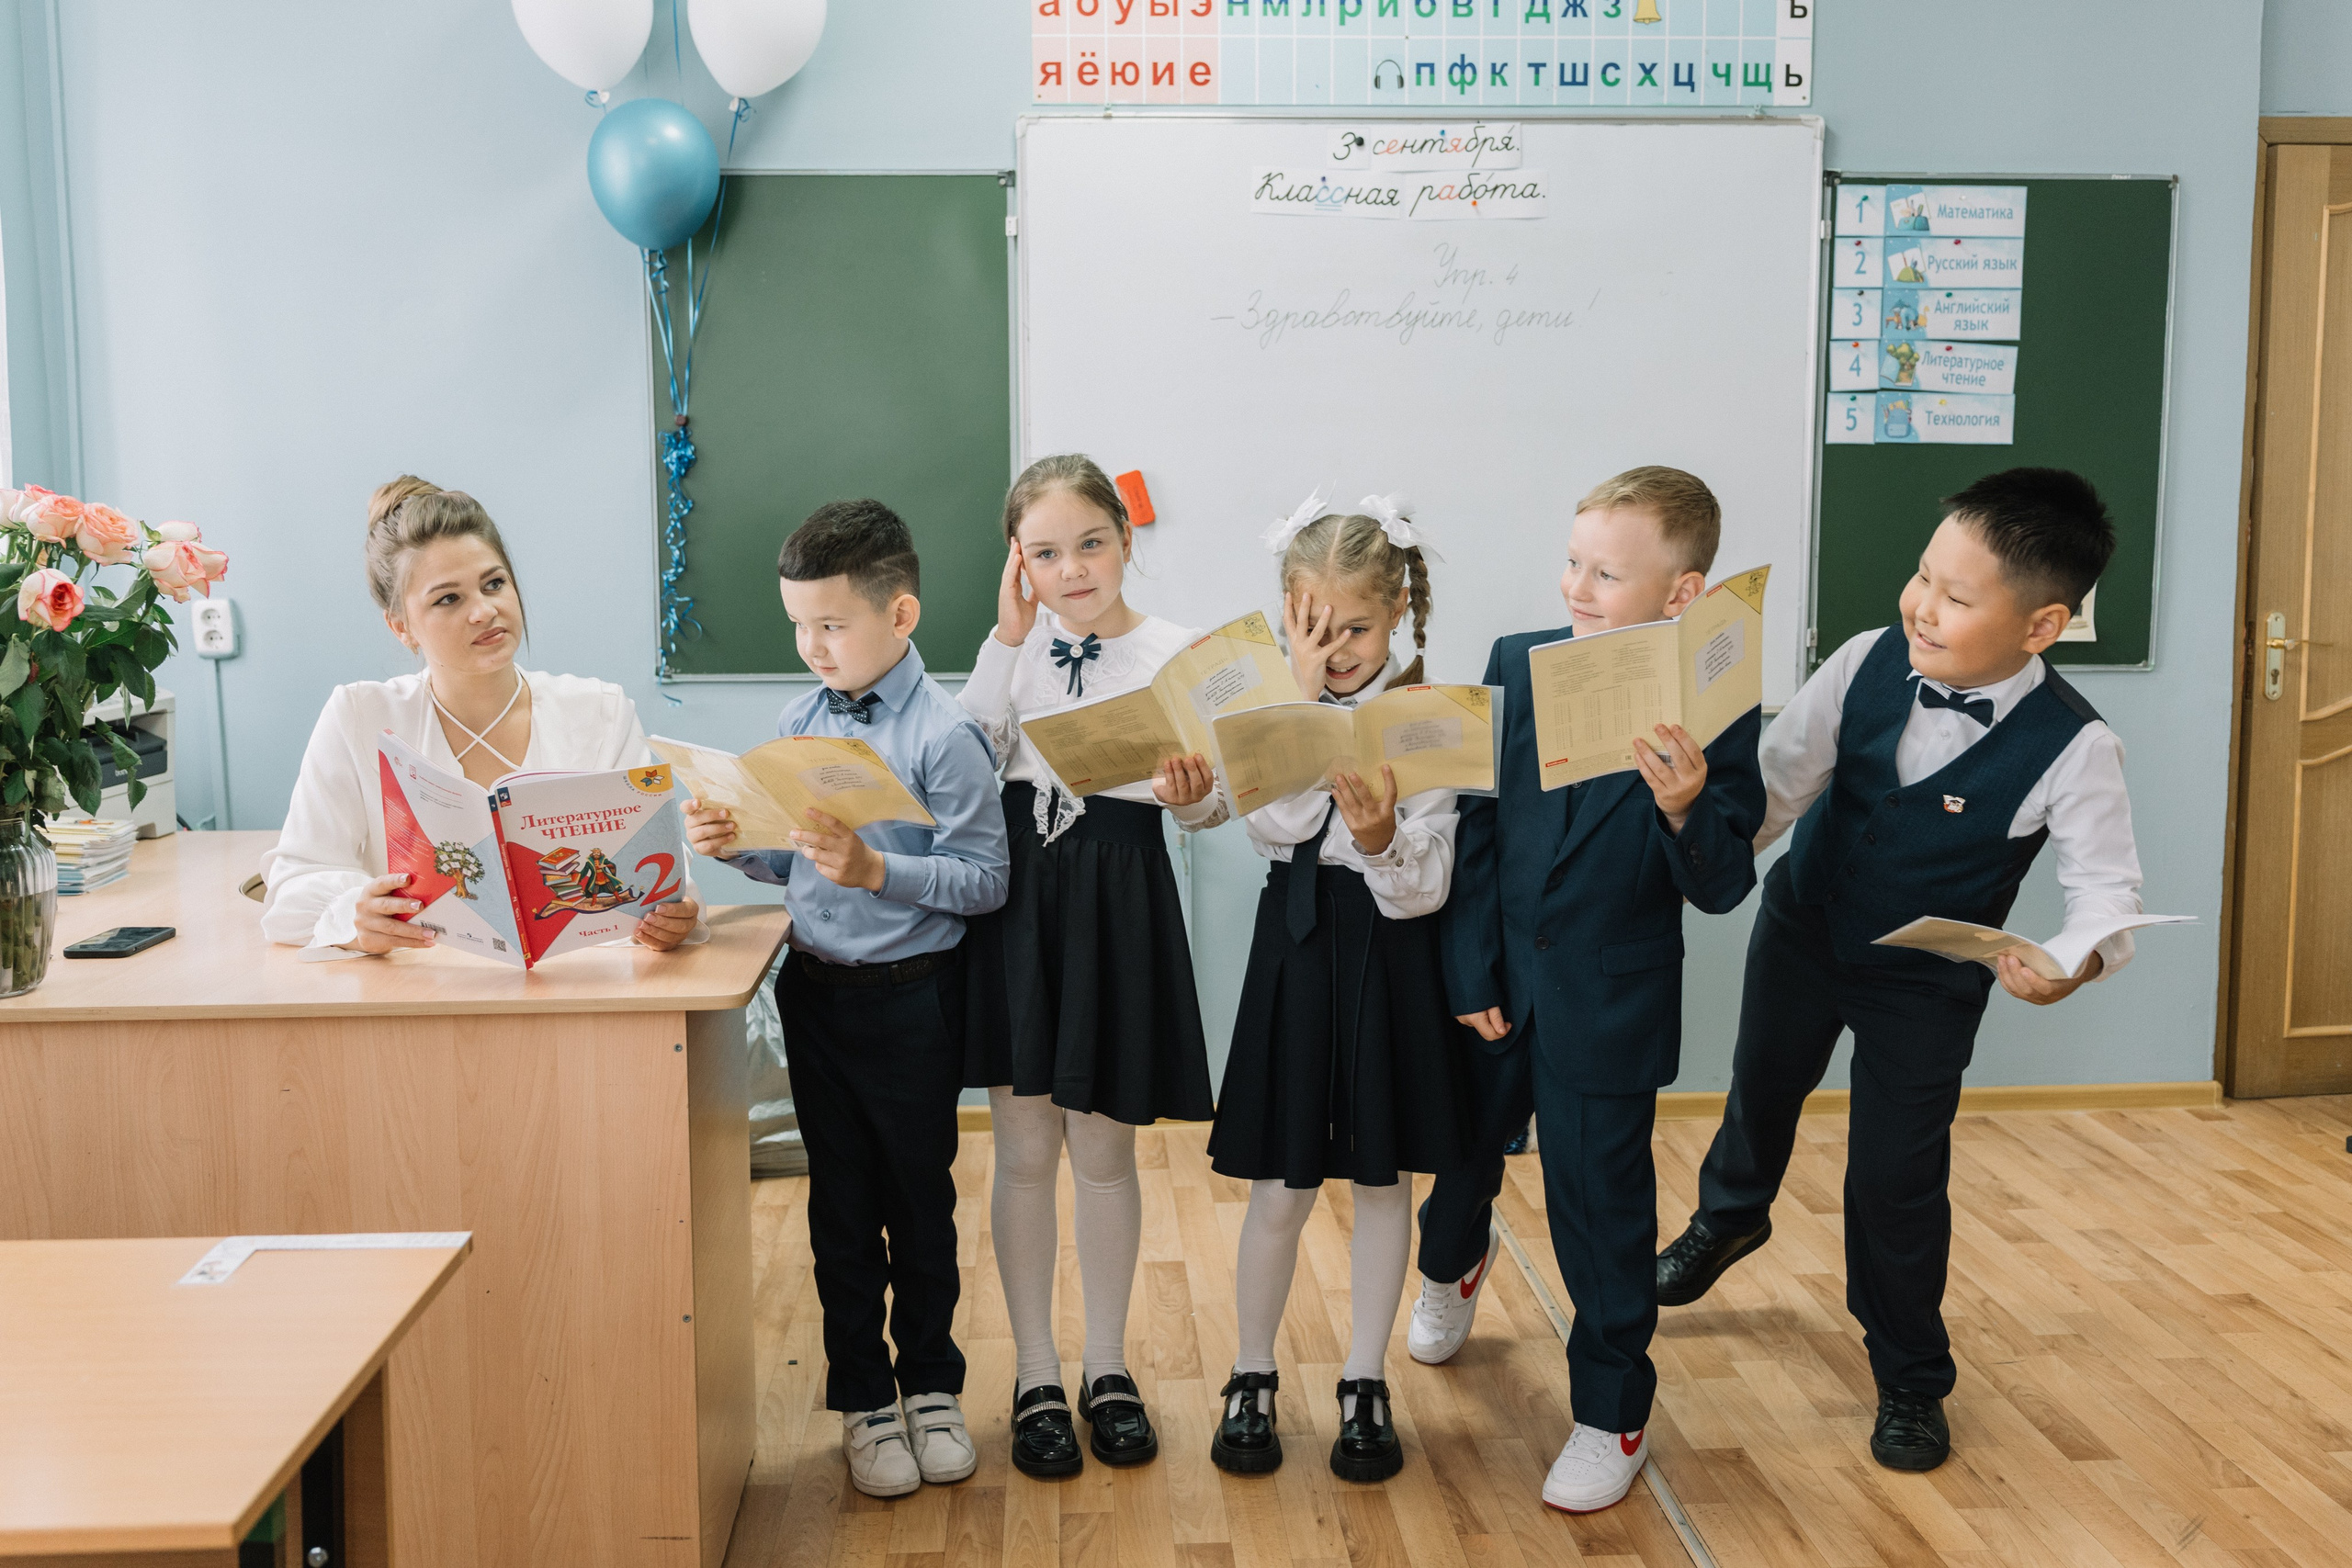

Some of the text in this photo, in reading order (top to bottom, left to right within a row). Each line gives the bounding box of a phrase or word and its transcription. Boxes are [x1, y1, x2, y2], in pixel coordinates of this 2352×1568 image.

[1039, 51, 1804, 96] я ё ю и е п ф к т ш с х ц ч щ ь
[1254, 172, 1400, 206] Классная
[1937, 204, 2014, 220] Математика
[1854, 251, 2018, 275] 2 Русский язык
[1852, 298, 2009, 326] 3 Английский
[1953, 319, 1989, 332] язык
[1849, 351, 2005, 378] 4 Литературное
[1941, 372, 1986, 387] чтение
[1846, 408, 2000, 431] 5 Технология
[520, 802, 642, 831] Литературное
[540, 818, 627, 840] ЧТЕНИЕ
[634, 852, 682, 908] 2
[579, 924, 619, 938] Часть 1
